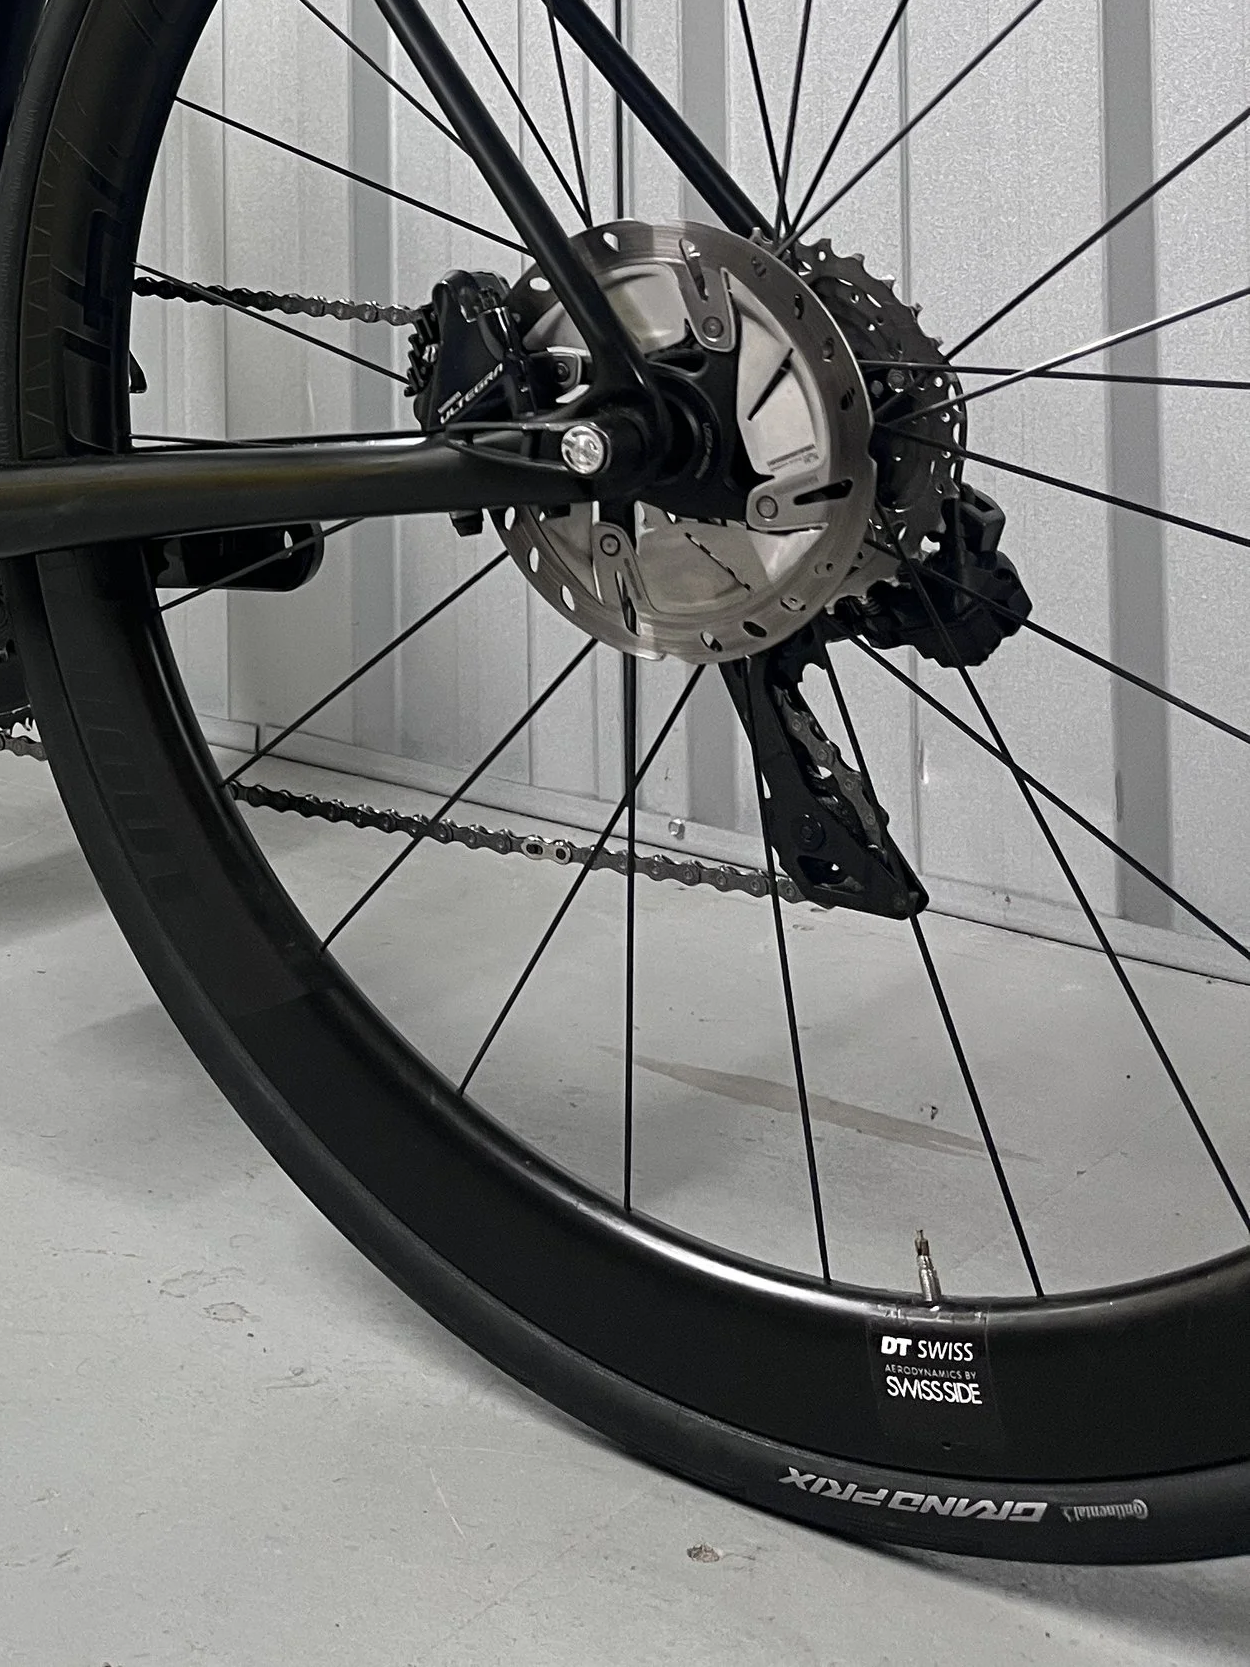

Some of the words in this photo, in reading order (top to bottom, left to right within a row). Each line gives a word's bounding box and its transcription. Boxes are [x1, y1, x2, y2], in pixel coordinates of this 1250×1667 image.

[880, 1335, 912, 1356] DT
[917, 1339, 974, 1362] SWISS
[884, 1364, 962, 1380] AERODYNAMICS
[964, 1370, 977, 1381] BY
[778, 1465, 889, 1505] PRIX
[888, 1490, 1049, 1523] GRAND
